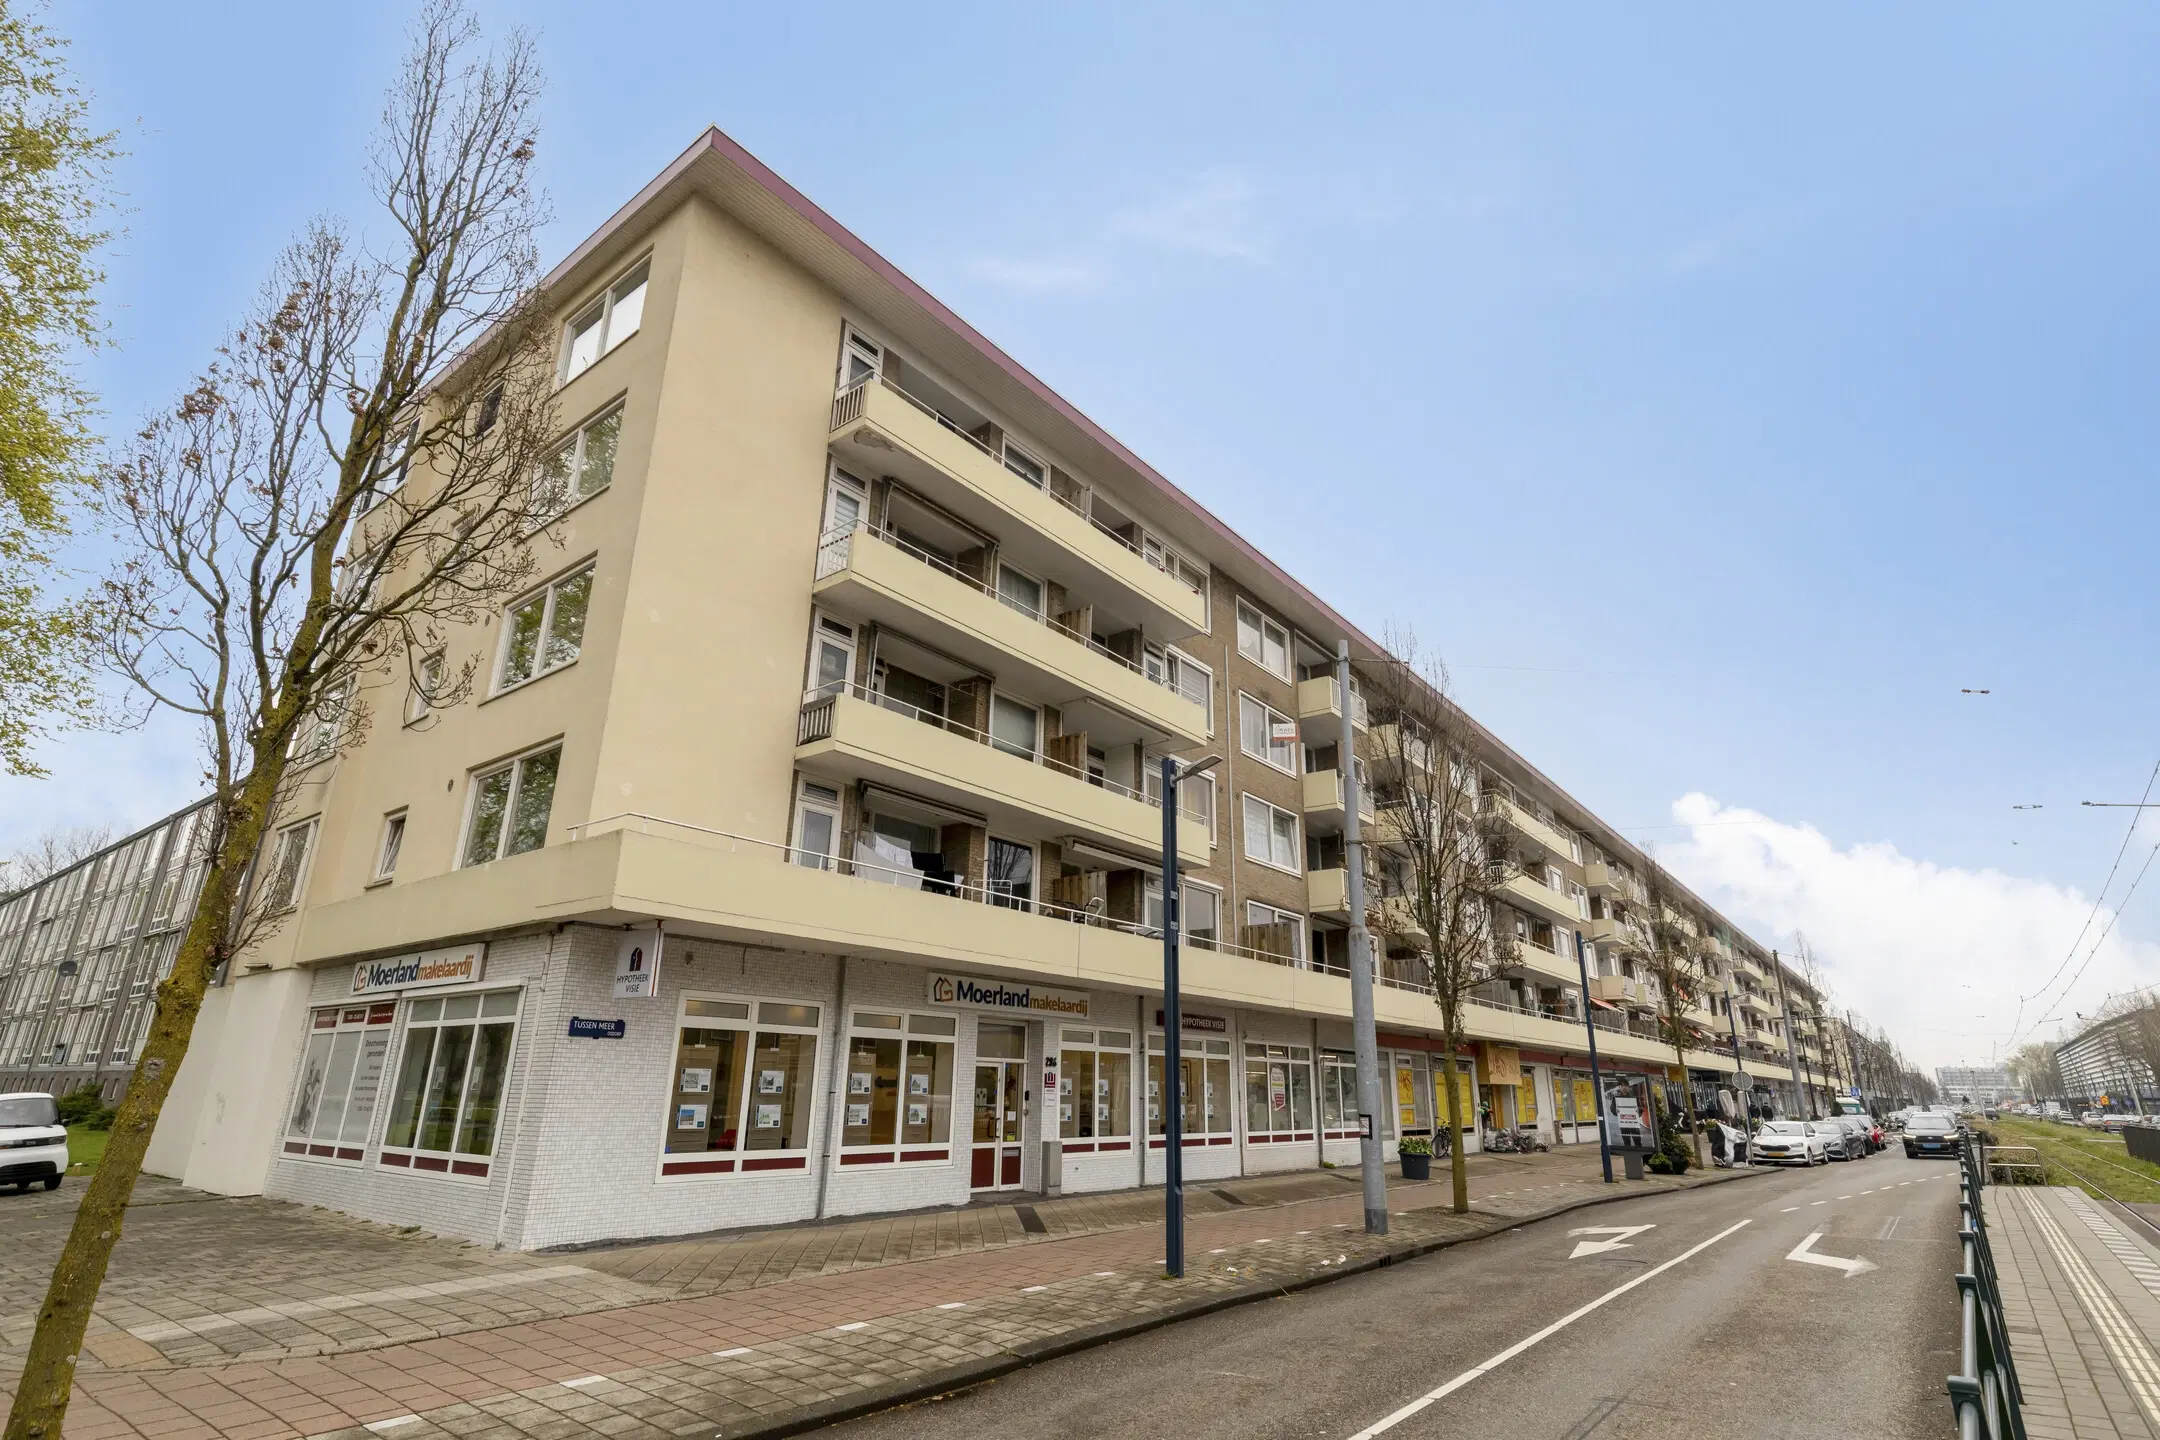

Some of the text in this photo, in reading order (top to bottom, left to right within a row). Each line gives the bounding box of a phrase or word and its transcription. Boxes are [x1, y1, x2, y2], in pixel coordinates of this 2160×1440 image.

[616, 974, 649, 984] HYPOTHEEK
[625, 984, 640, 993] VISIE
[573, 1020, 615, 1030] TUSSEN MEER
[1181, 1017, 1225, 1029] HYPOTHEEK VISIE
